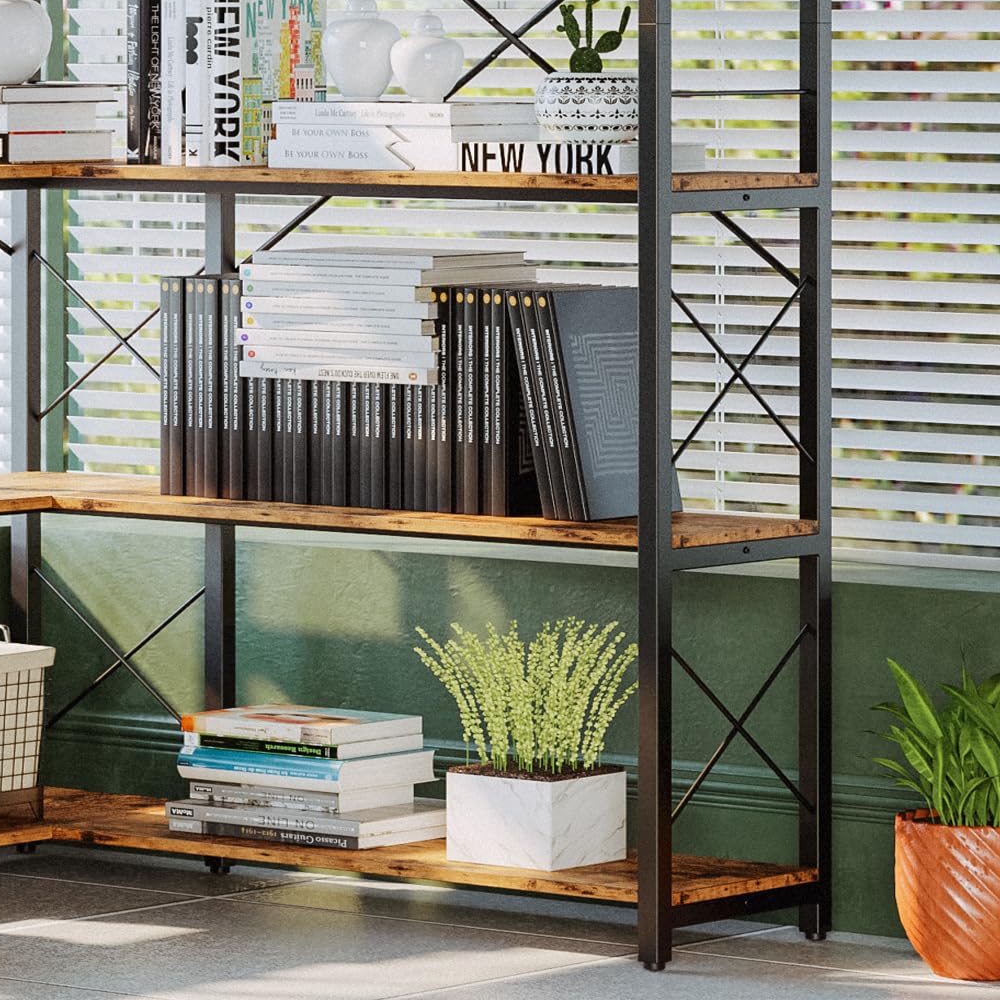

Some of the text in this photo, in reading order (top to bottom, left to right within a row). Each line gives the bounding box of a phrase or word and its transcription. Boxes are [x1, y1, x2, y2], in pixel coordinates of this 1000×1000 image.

[151, 4, 160, 24] THE
[151, 26, 160, 56] LIGHT
[151, 57, 160, 71] OF
[150, 73, 160, 98] NEW
[151, 99, 160, 129] YORK
[214, 70, 240, 162] YORK
[292, 128, 300, 136] BE
[350, 129, 369, 137] BOSS
[284, 150, 368, 159] BE YOUR OWN BOSS
[462, 143, 614, 175] NEW YORK
[524, 376, 533, 408] COMPLETE
[530, 409, 539, 446] COLLECTION
[539, 377, 548, 409] COMPLETE
[545, 410, 554, 447] COLLECTION
[553, 378, 562, 409] COMPLETE
[560, 411, 569, 448] COLLECTION
[265, 744, 322, 756] Design Research
[171, 808, 192, 817] MoMA
[258, 815, 289, 826] LINE
[295, 819, 315, 830] ON
[280, 832, 314, 844] Guitars
[316, 836, 348, 849] Picasso
